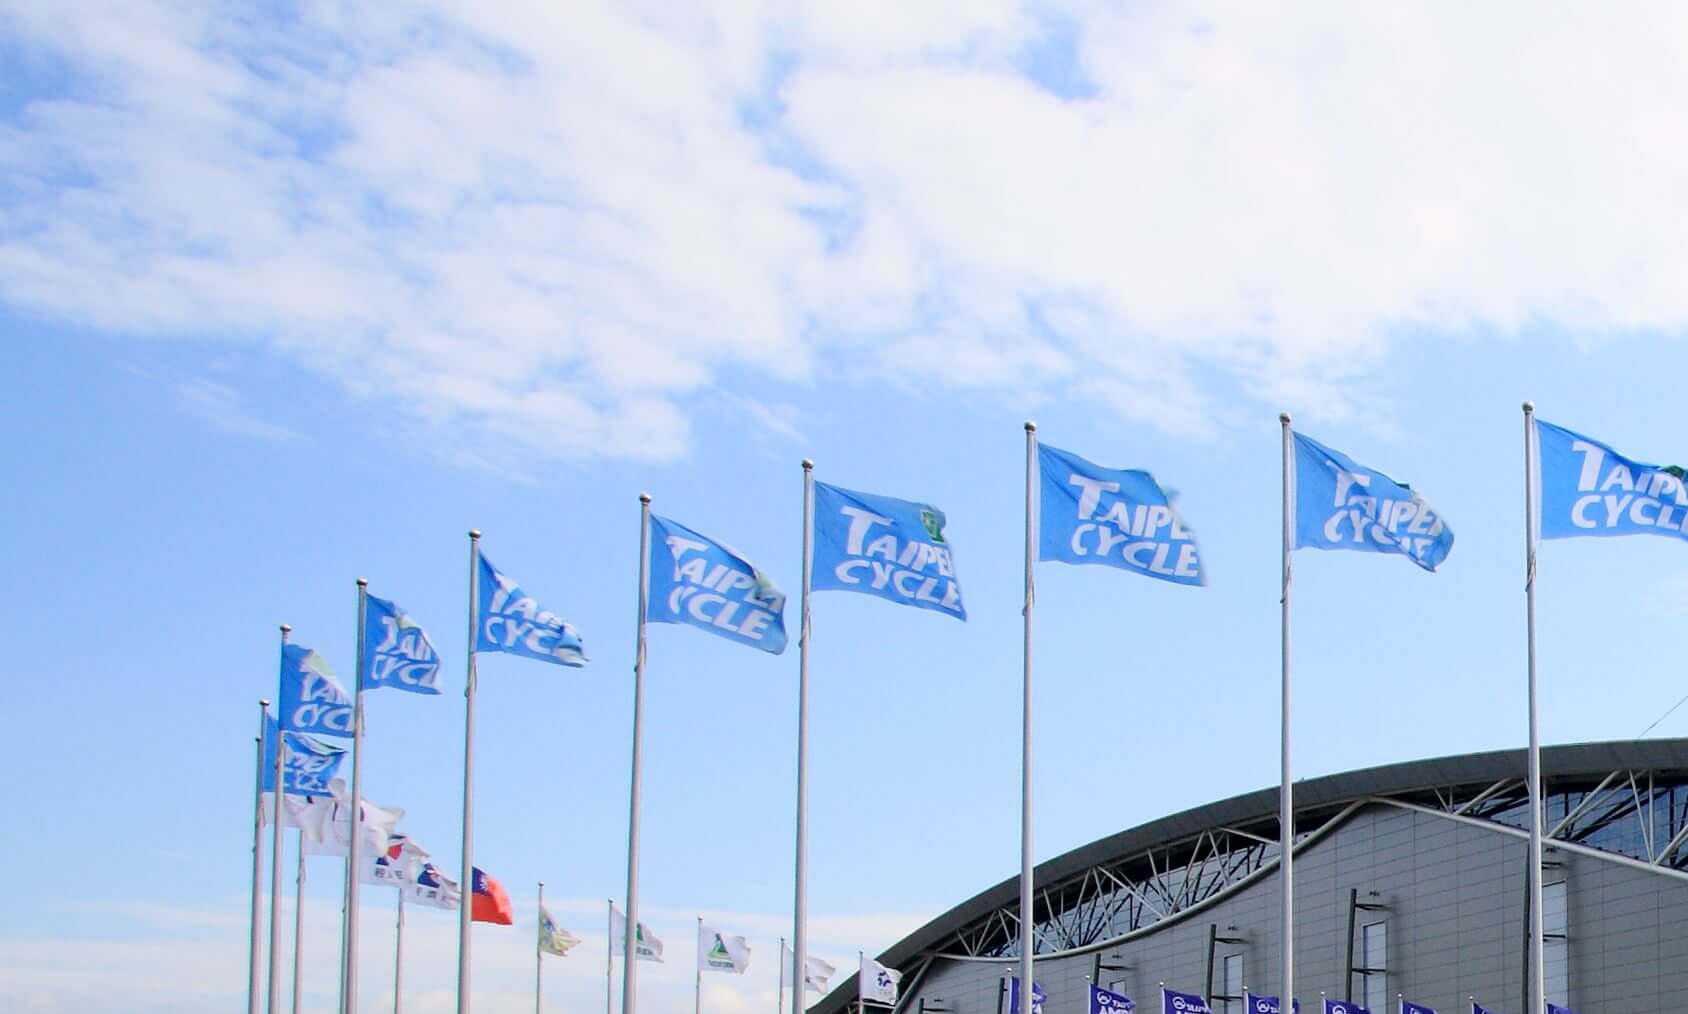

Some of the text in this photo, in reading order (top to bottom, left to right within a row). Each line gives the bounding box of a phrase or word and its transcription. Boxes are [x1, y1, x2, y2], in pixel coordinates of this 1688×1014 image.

[1069, 473, 1192, 540] TAIP
[1071, 523, 1200, 577] CYCLE
[835, 558, 962, 612] CYCLE
